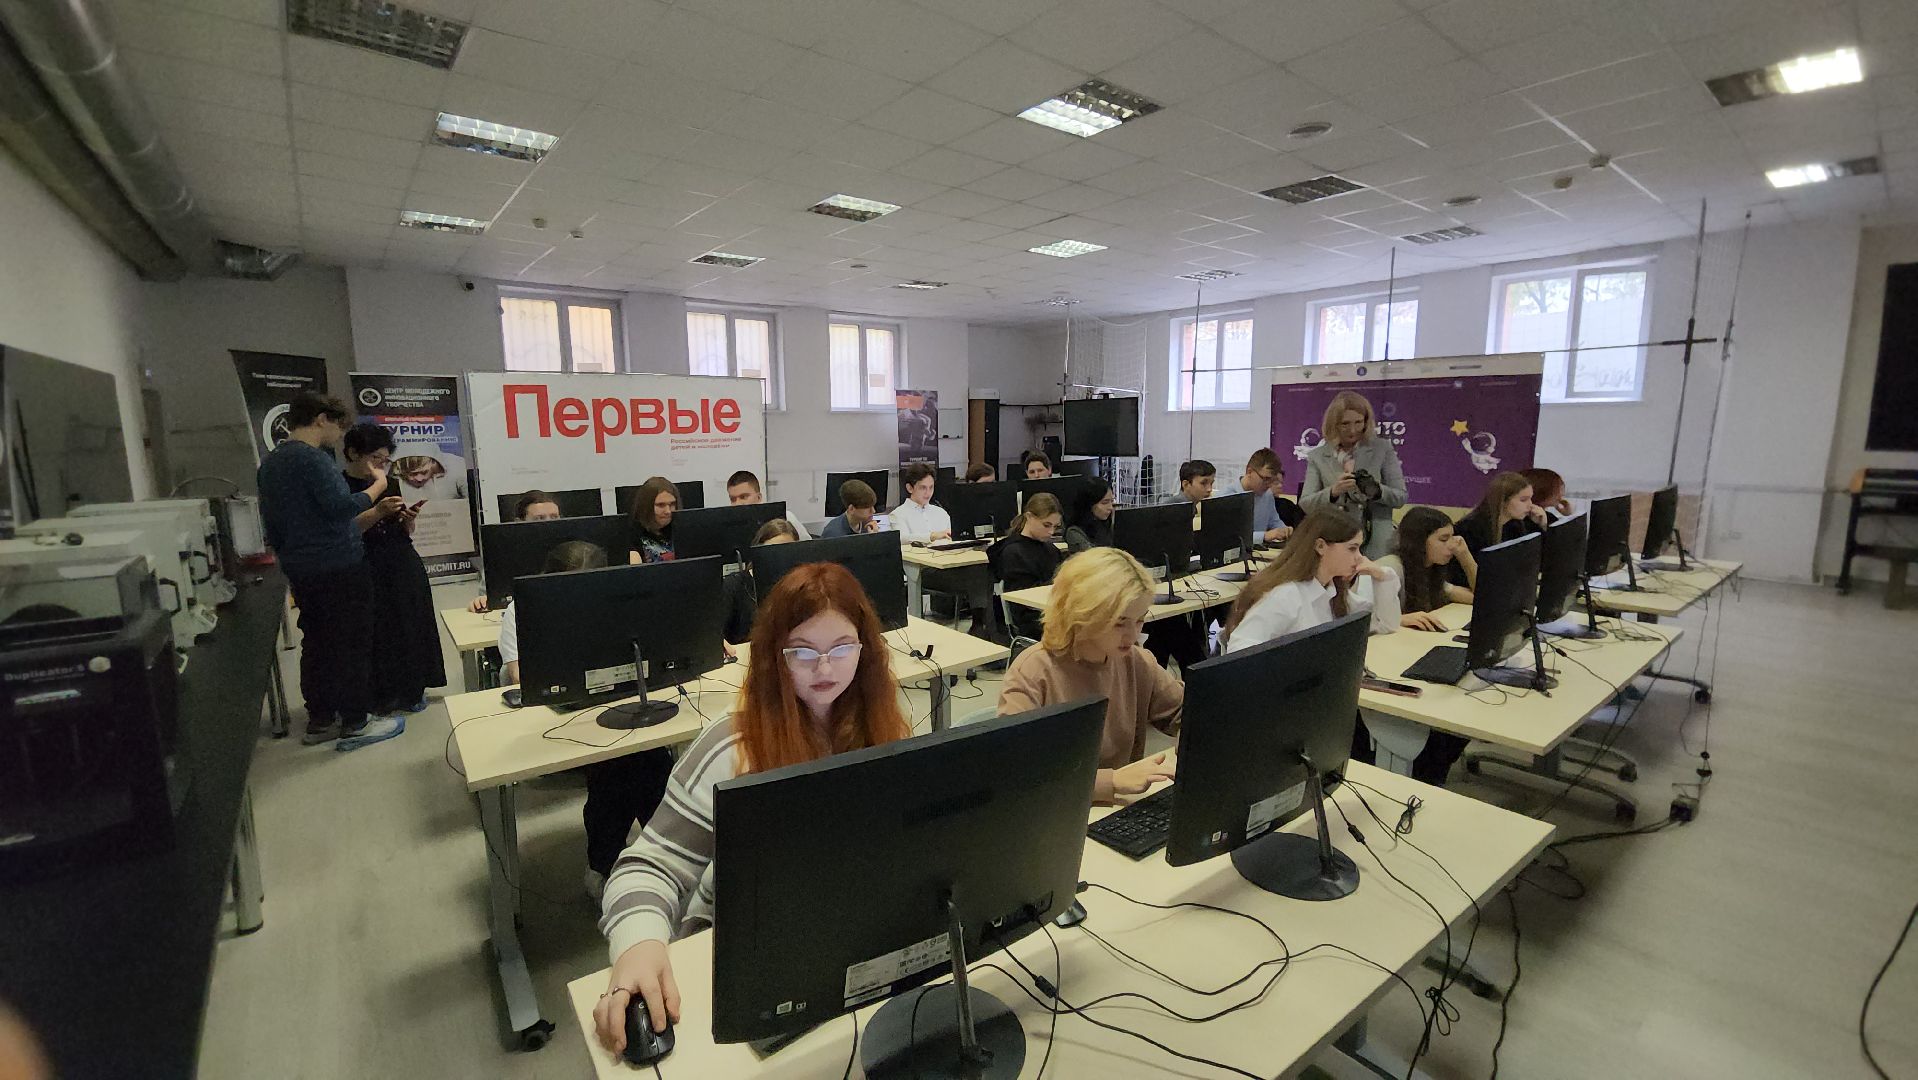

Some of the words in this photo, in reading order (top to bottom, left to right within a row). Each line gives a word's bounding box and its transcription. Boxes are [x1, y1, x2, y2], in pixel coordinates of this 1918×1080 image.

[503, 384, 741, 453] Первые
[382, 425, 444, 435] УРНИР
[4, 666, 74, 681] Duplicator
